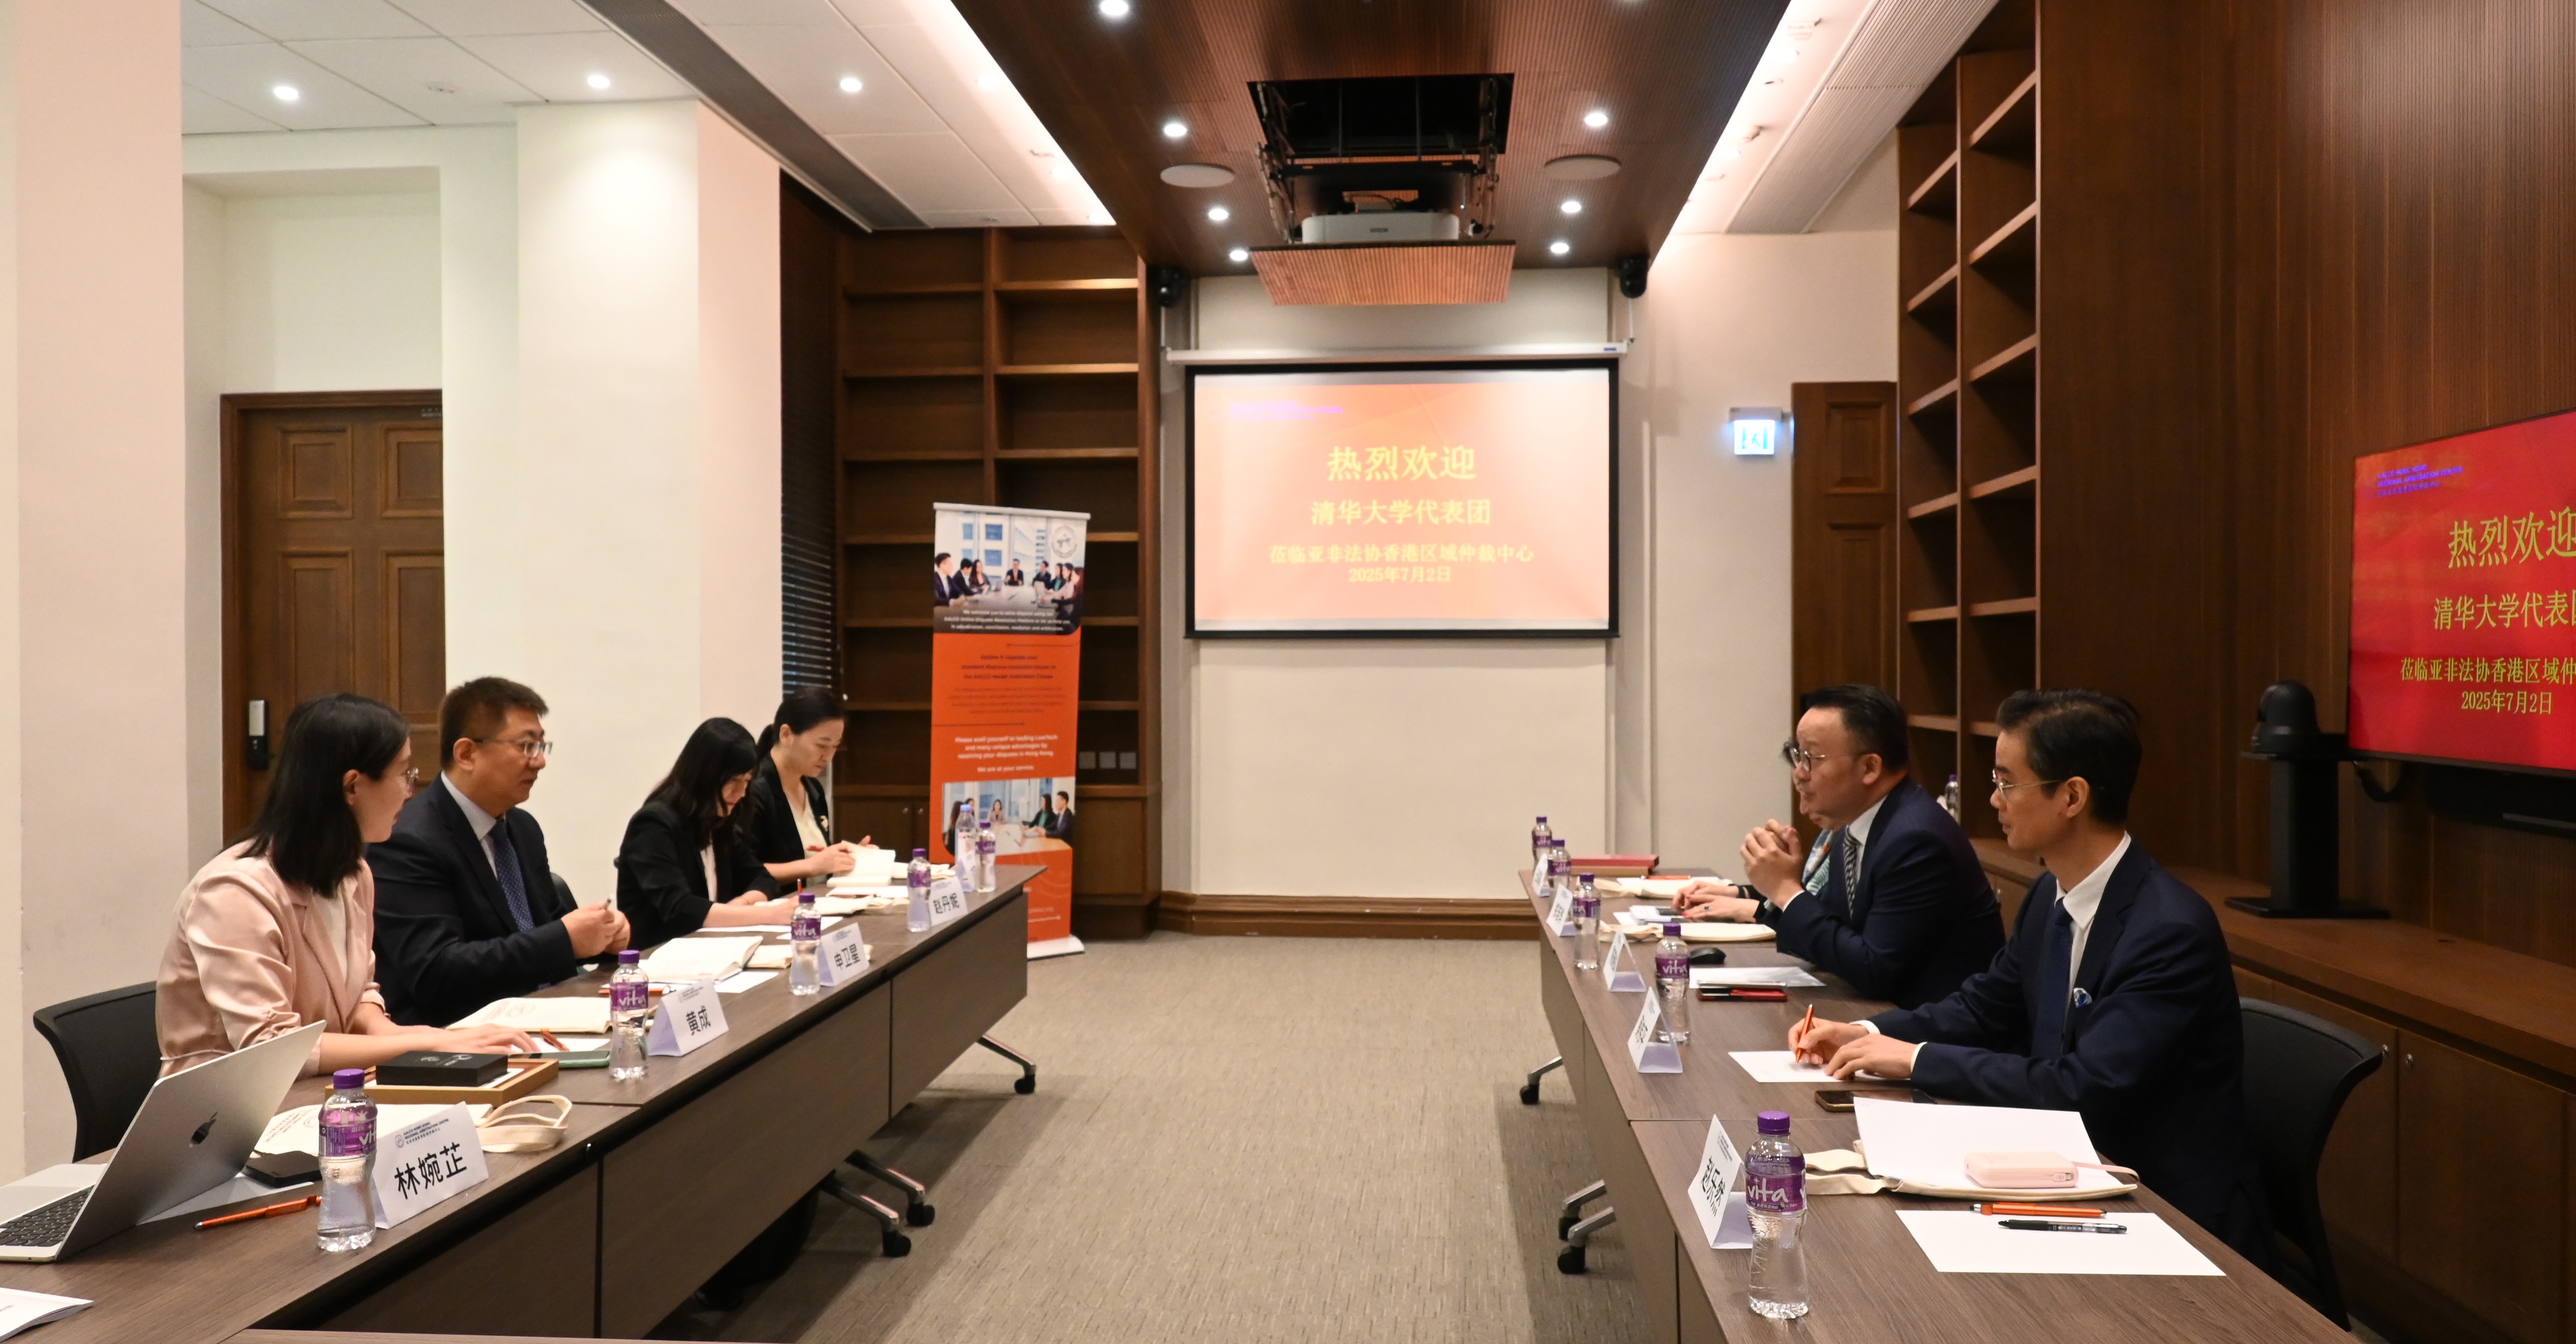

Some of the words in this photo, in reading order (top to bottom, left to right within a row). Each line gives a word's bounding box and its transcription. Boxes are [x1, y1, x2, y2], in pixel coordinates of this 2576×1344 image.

[1327, 445, 1477, 481] 热烈欢迎
[1311, 499, 1491, 526] 清华大学代表团
[2448, 506, 2576, 568] 热烈欢迎
[1269, 544, 1534, 564] 莅临亚非法协香港区域仲裁中心
[1349, 566, 1451, 584] 2025年7月2日
[2434, 589, 2576, 630] 清华大学代表
[2461, 689, 2552, 715] 2025年7月2日
[1662, 960, 1688, 974] vita
[618, 988, 647, 1006] vita
[359, 1121, 377, 1145] vit
[394, 1142, 468, 1200] 林婉芷
[1748, 1177, 1789, 1202] vita
